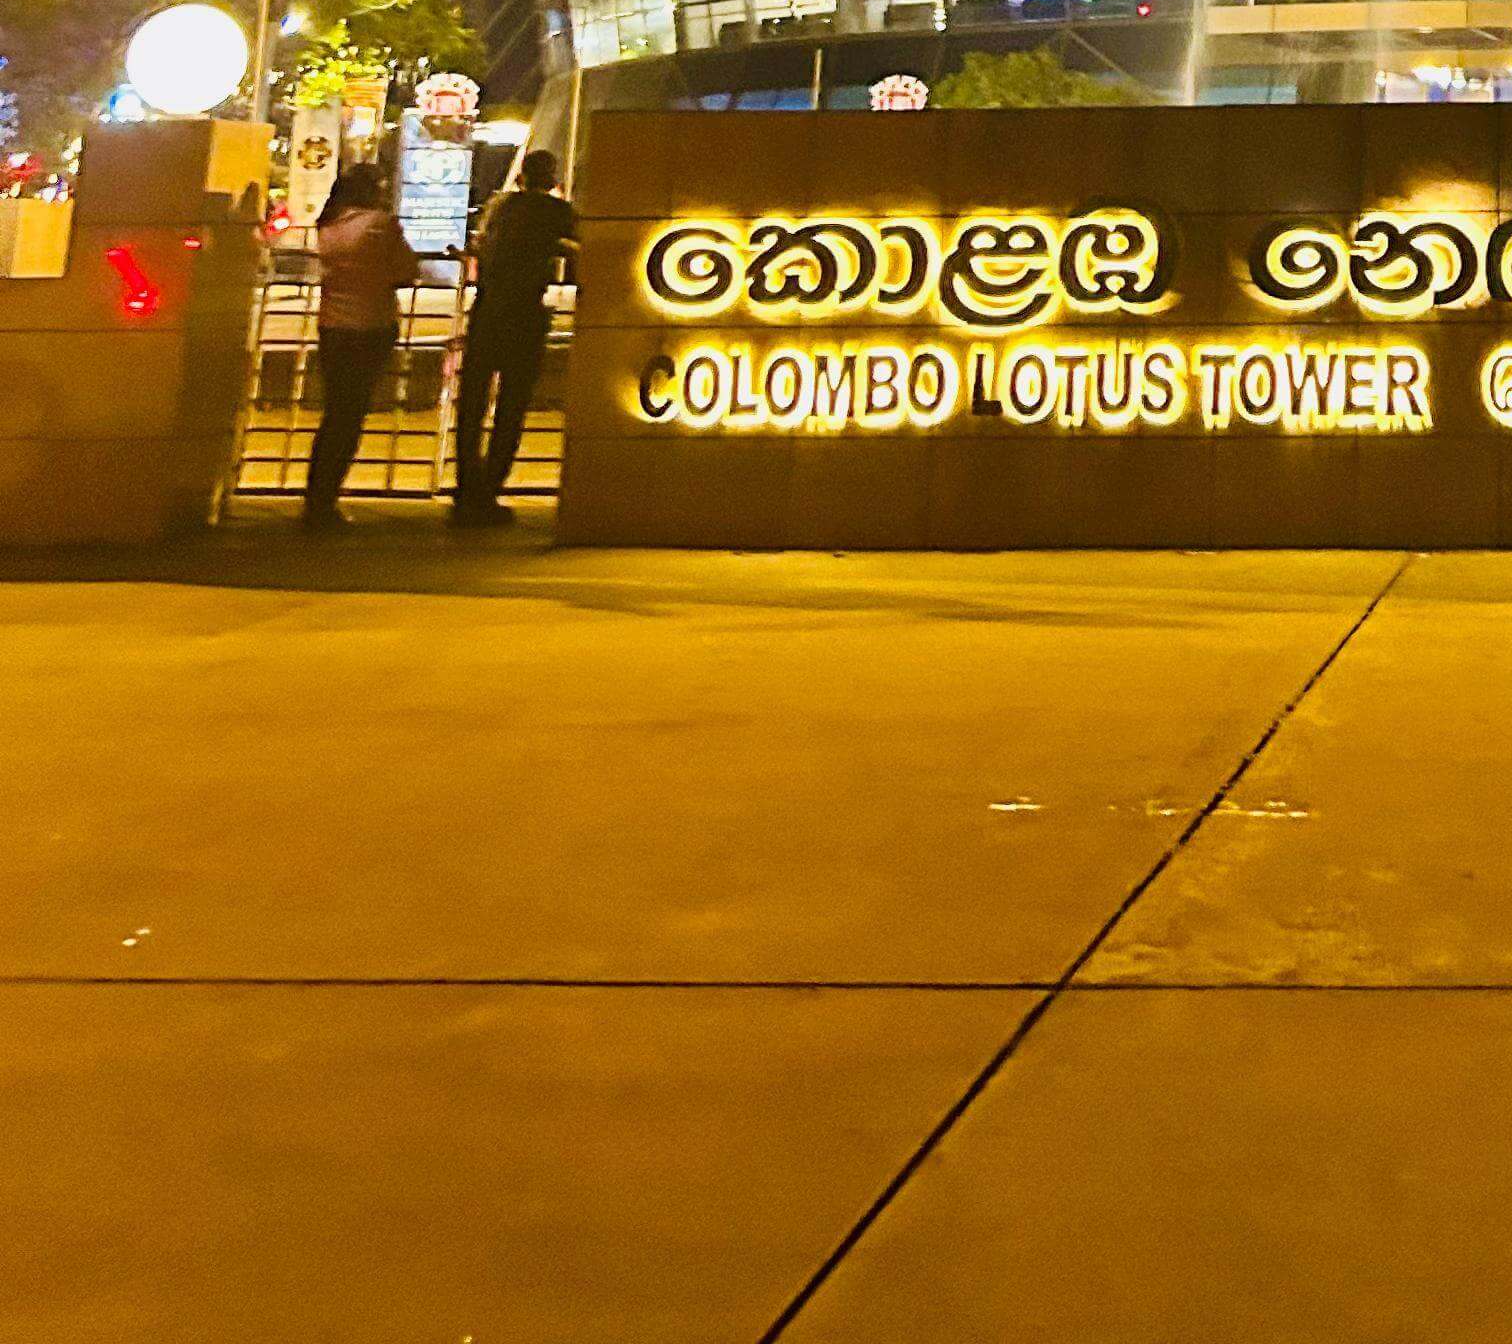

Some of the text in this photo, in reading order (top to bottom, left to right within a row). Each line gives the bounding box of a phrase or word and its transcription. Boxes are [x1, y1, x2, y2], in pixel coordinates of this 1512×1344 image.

[639, 352, 1428, 418] COLOMBO LOTUS TOWER
